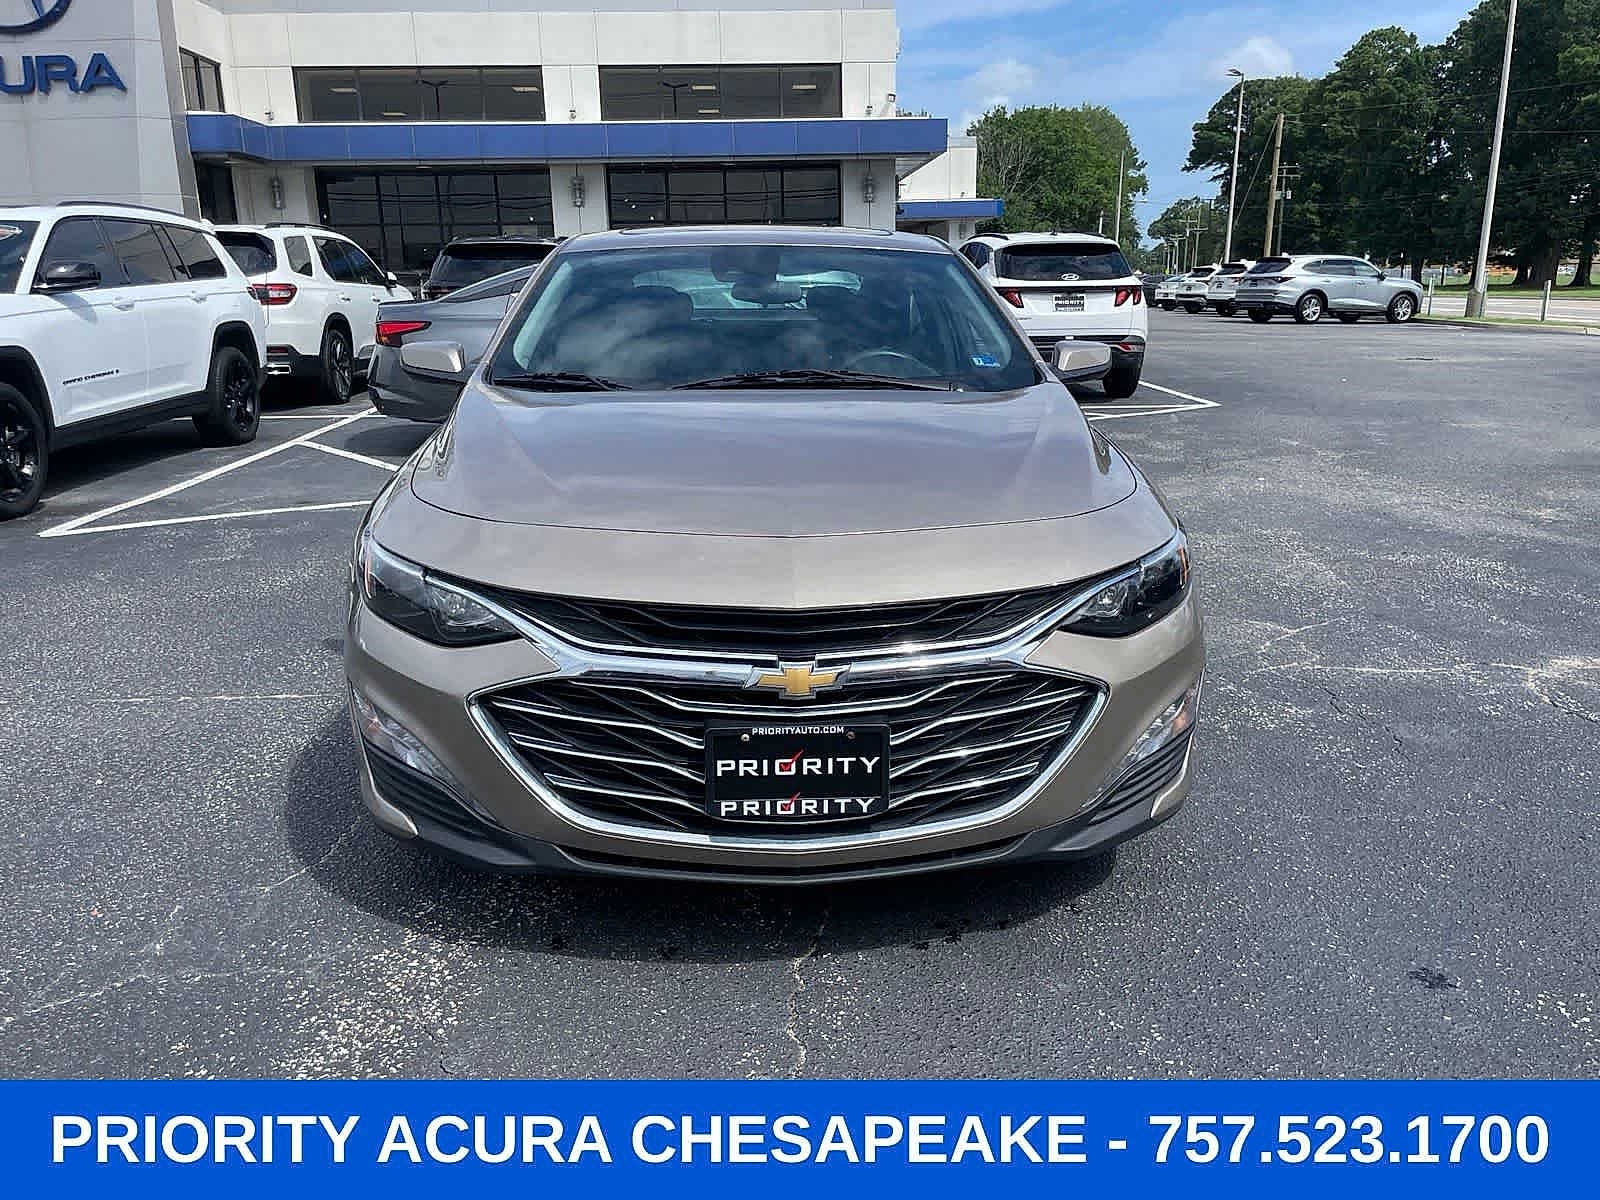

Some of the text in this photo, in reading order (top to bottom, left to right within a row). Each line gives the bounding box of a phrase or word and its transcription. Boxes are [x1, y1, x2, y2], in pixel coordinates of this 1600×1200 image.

[751, 726, 844, 736] PRIORITYAUTO.COM
[716, 756, 881, 777] PRIORITY
[720, 798, 876, 817] PRIORITY
